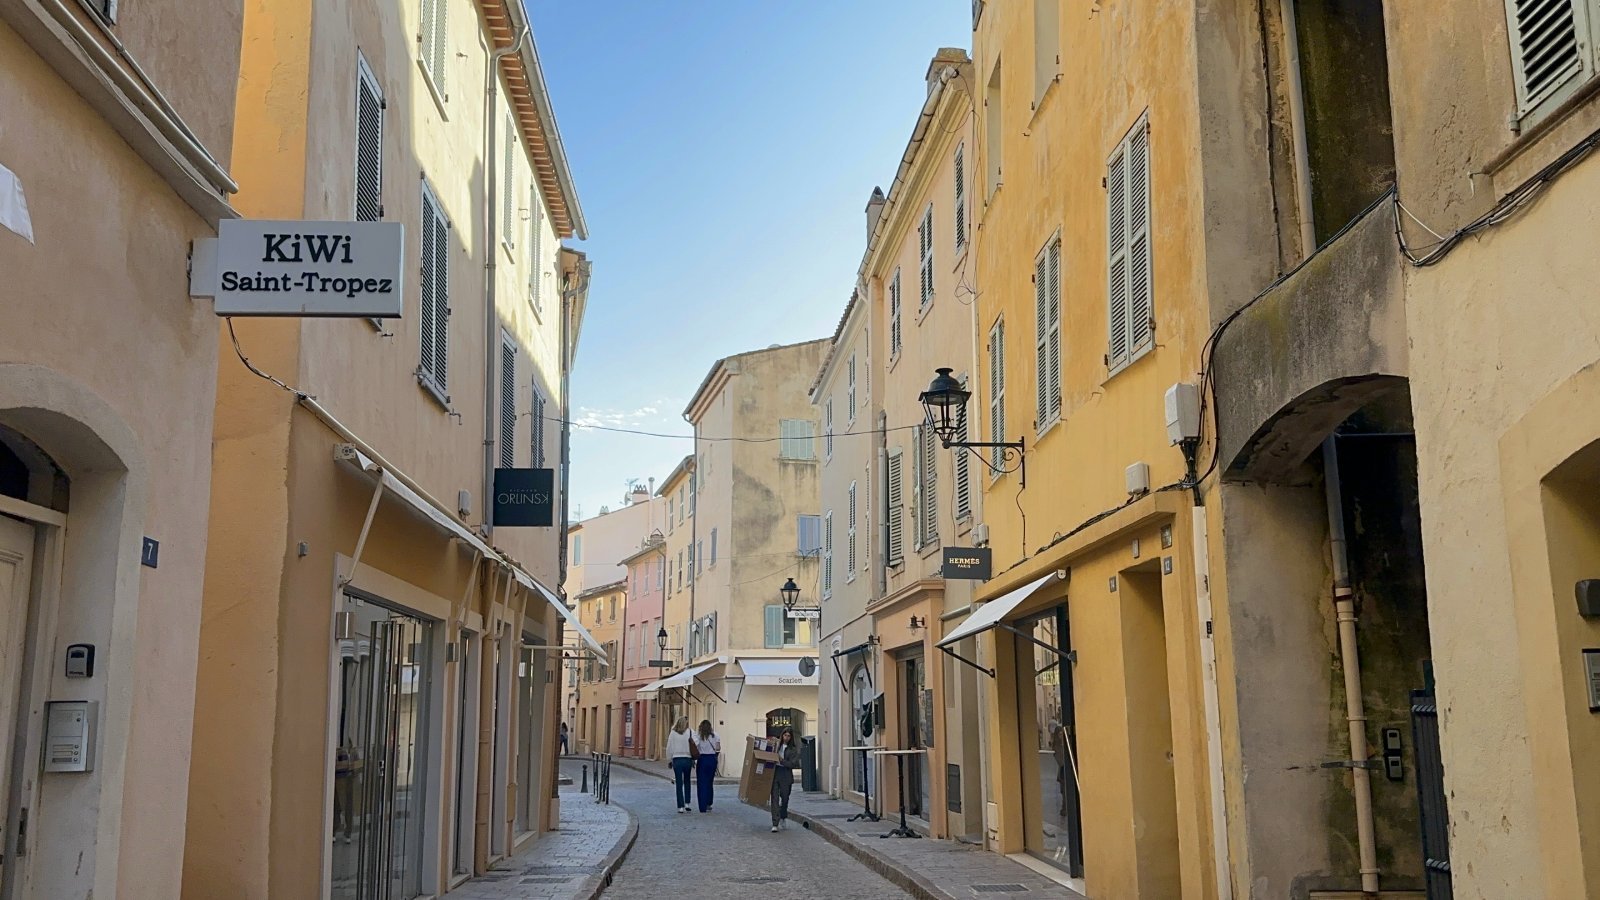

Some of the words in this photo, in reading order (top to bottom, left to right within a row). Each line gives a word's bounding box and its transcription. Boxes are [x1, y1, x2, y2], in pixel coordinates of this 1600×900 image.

[262, 233, 353, 263] KiWi
[221, 271, 392, 298] Saint-Tropez
[148, 542, 154, 560] 7
